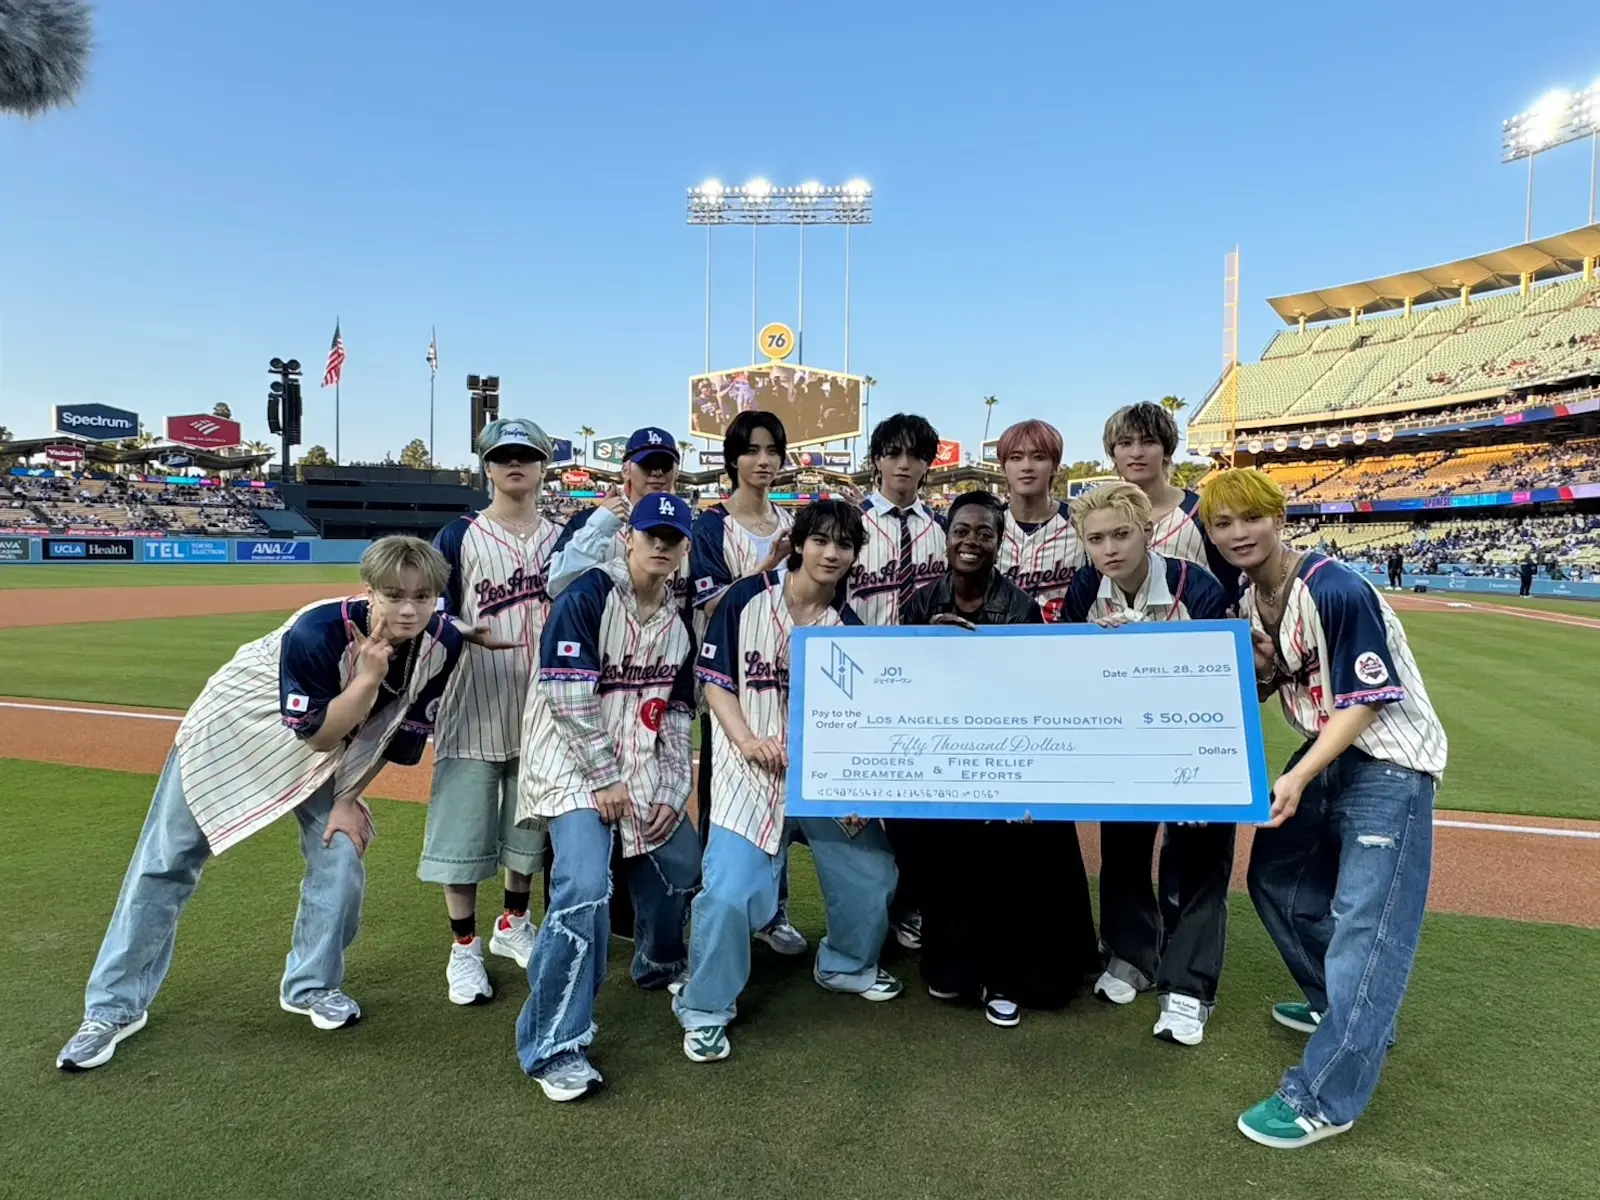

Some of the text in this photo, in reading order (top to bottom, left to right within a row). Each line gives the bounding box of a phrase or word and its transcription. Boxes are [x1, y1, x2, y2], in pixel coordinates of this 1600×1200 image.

[767, 333, 786, 347] 76
[62, 412, 129, 428] Spectrum
[648, 430, 663, 444] LA
[659, 497, 676, 516] LA
[54, 544, 127, 555] UCLA Health
[146, 543, 184, 558] TEL
[251, 543, 282, 554] ANA
[849, 564, 877, 589] Los
[475, 578, 506, 608] Los
[745, 650, 770, 679] Los
[880, 667, 902, 676] JO1
[1102, 664, 1231, 678] Date APRIL 28, 2025
[812, 709, 862, 719] Pay to the
[1143, 711, 1224, 725] $ 50,000
[815, 720, 858, 729] Order of
[867, 715, 1123, 725] LOS ANGELES DODGERS FOUNDATION
[889, 734, 1076, 757] Fifty Thousand Dollars
[1198, 746, 1238, 755] Dollars
[851, 756, 915, 766] DODGERS
[948, 757, 1035, 767] FIRE RELIEF
[811, 770, 828, 779] For
[842, 769, 924, 779] DREAMTEAM
[933, 765, 943, 775] &
[961, 770, 1023, 780] EFFORTS
